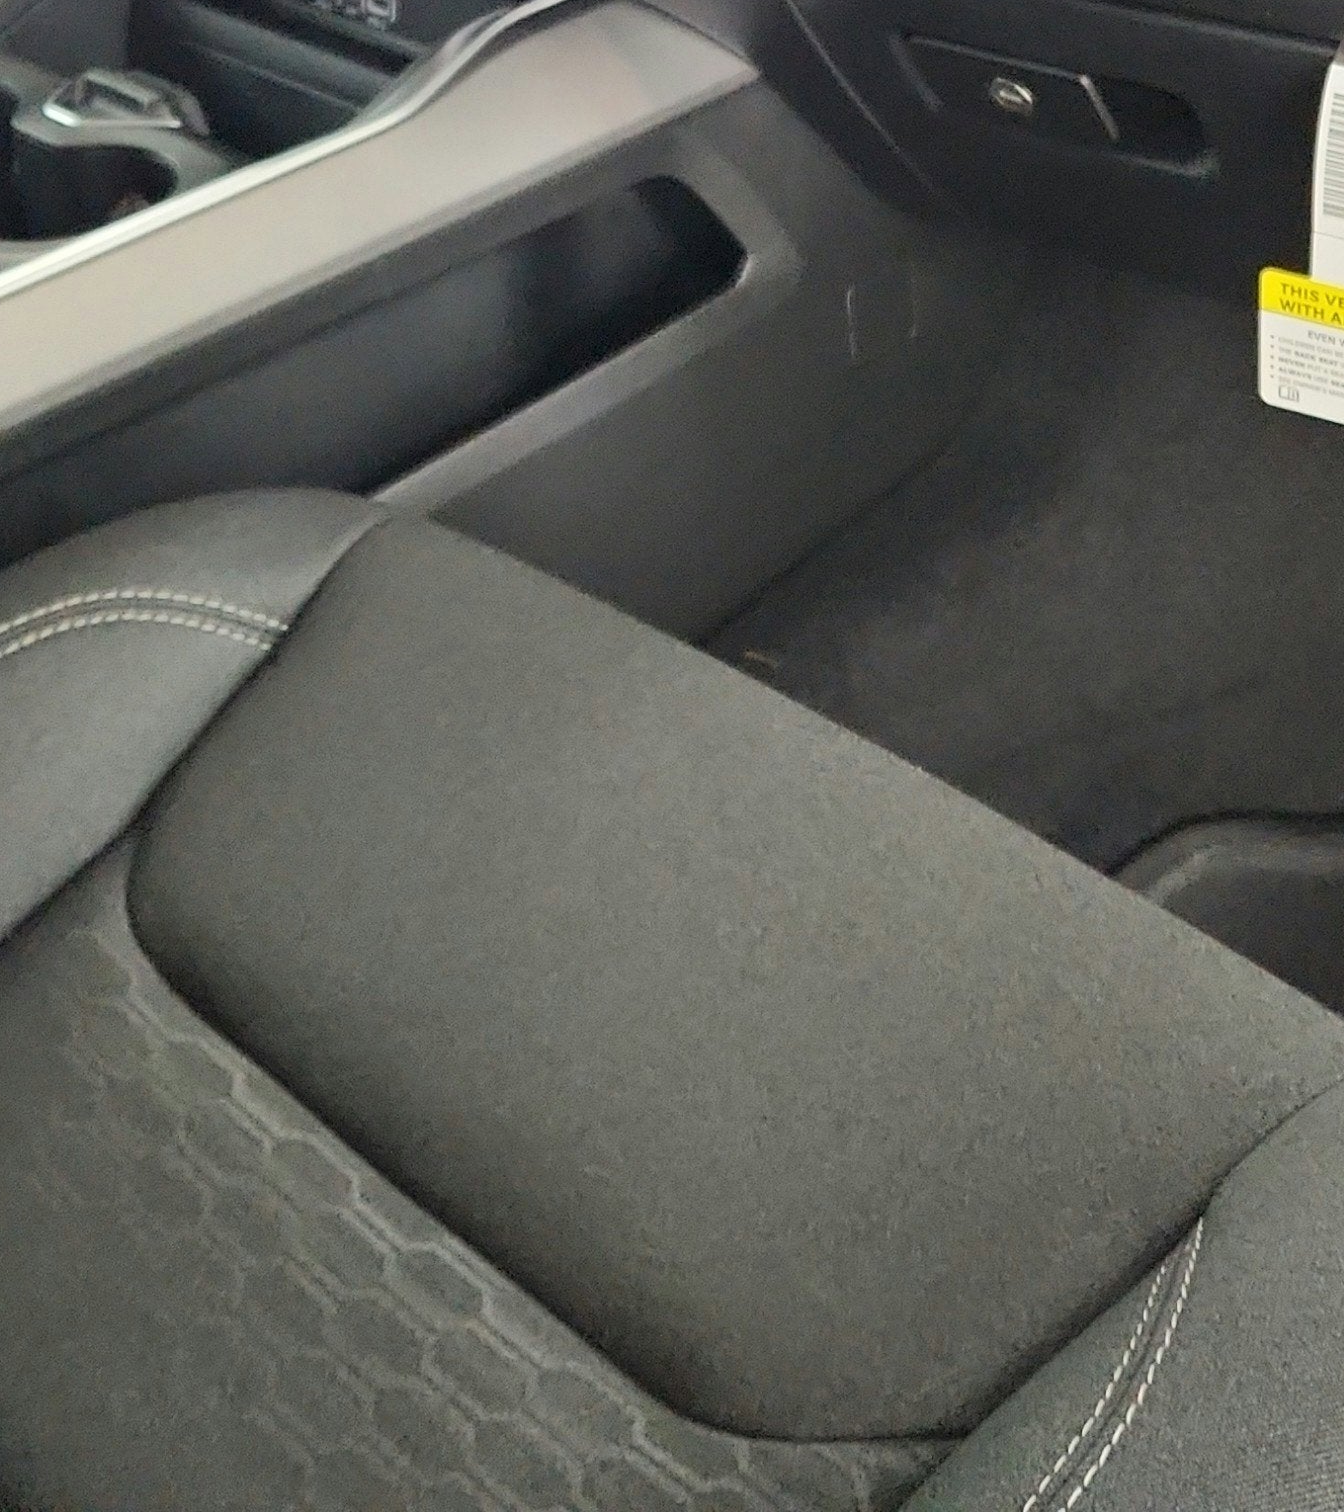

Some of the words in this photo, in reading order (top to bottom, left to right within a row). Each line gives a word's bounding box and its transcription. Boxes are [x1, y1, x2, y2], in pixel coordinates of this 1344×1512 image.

[1280, 282, 1320, 303] THIS
[1279, 297, 1325, 320] WITH
[1307, 330, 1336, 345] EVEN
